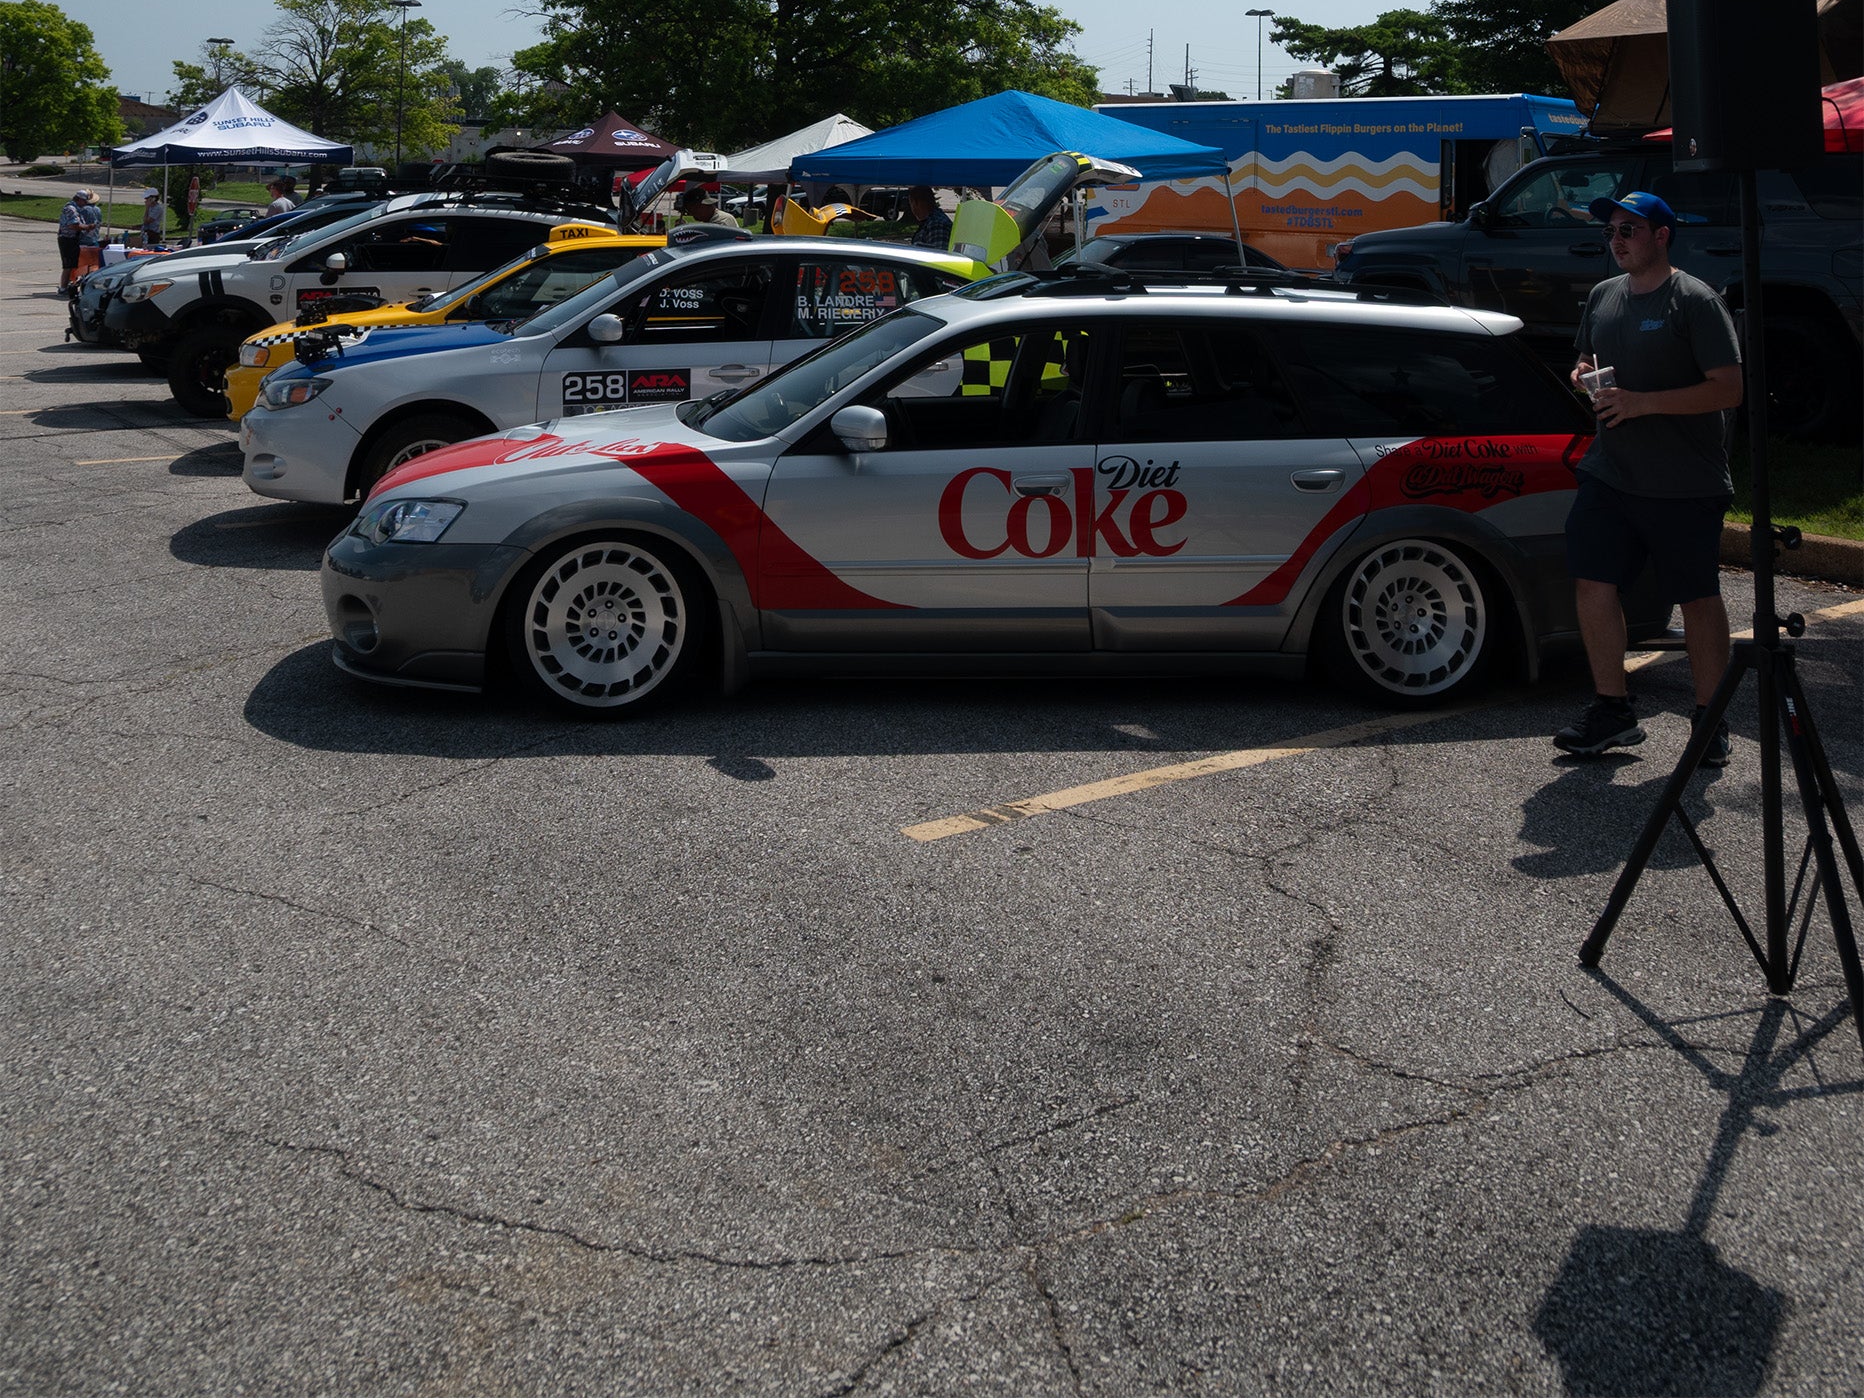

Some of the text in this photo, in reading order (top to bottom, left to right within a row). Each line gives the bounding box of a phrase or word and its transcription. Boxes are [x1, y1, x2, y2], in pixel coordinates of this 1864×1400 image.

[213, 117, 247, 126] SUNSET
[217, 122, 271, 130] SUBARU
[1265, 123, 1464, 135] The Tastiest Flippin Burgers on the Planet!
[614, 141, 661, 149] SUBARU
[197, 147, 328, 159] www.SunsetHillsSubaru.com
[1112, 199, 1130, 209] STL
[1261, 205, 1363, 217] tastedburgerstl.com
[560, 228, 589, 239] TAXI
[839, 271, 895, 293] 258
[672, 288, 704, 299] VOSS
[659, 299, 700, 309] J. Voss
[797, 295, 874, 307] B. LANDRE
[797, 308, 813, 319] M.
[631, 374, 687, 388] ARA
[565, 375, 625, 401] 258
[1375, 439, 1538, 459] Share a Diet Coke with
[1097, 455, 1181, 490] Diet
[938, 466, 1189, 559] Coke
